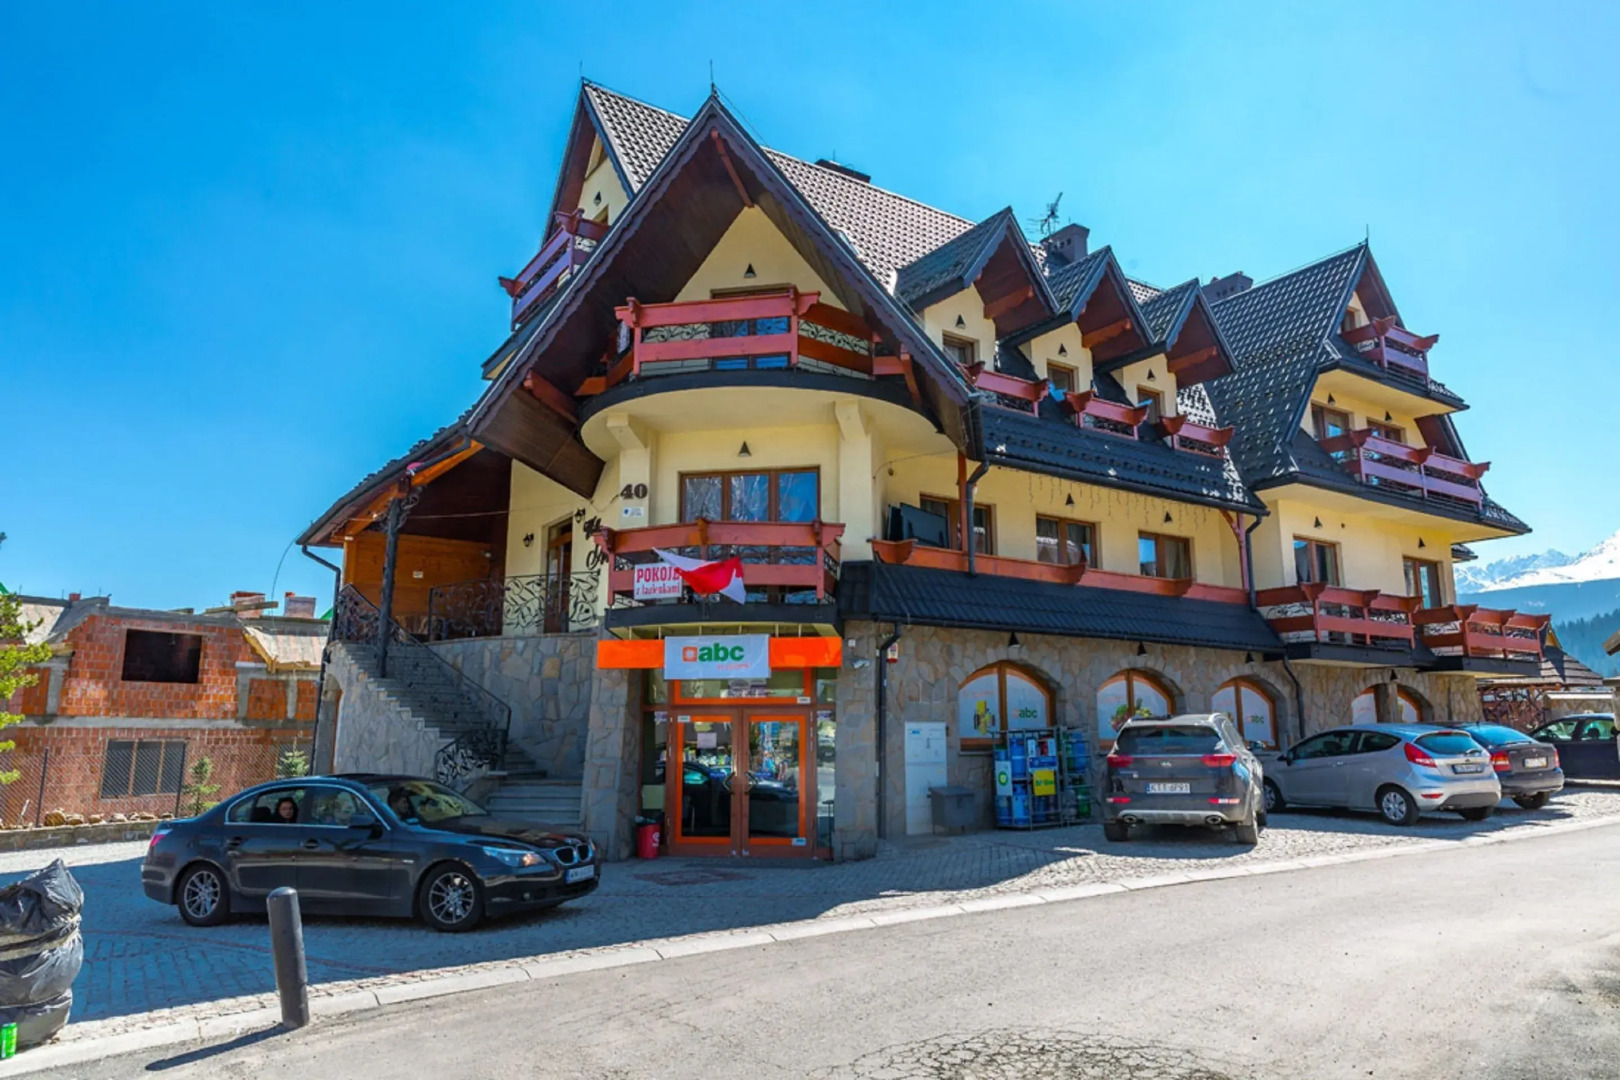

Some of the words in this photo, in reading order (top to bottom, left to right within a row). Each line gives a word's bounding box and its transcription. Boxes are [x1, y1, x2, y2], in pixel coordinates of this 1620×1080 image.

[620, 483, 648, 500] 40
[698, 642, 744, 662] abc
[1018, 707, 1038, 719] abc
